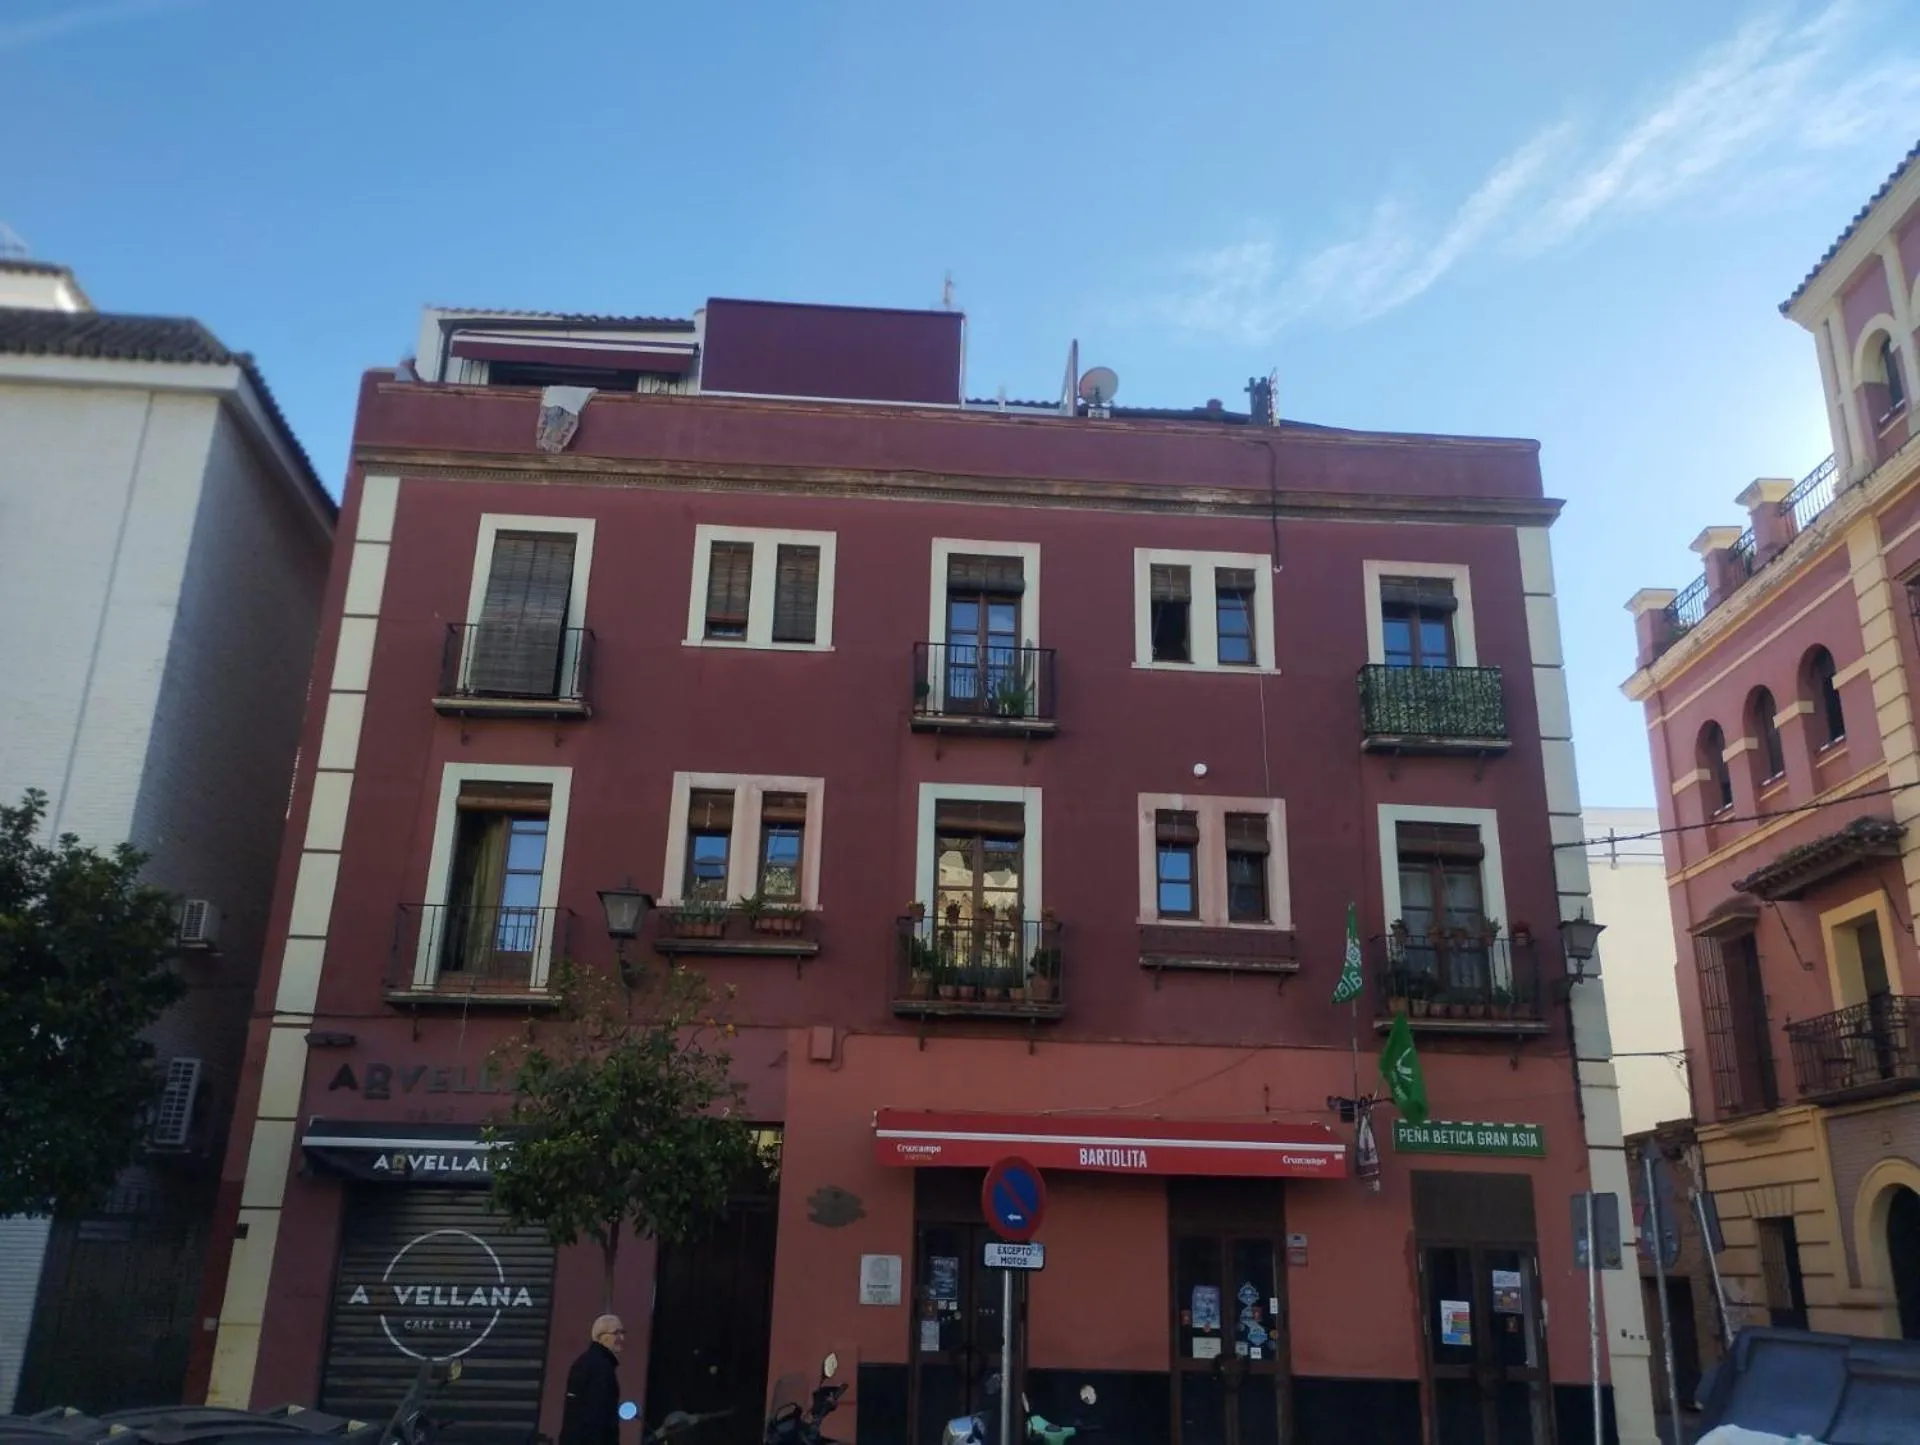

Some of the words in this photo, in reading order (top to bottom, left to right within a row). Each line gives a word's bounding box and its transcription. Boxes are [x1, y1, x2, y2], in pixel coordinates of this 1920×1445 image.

[1398, 1126, 1430, 1144] PEÑA
[1477, 1131, 1509, 1147] GRAN
[1512, 1132, 1538, 1148] ASIA
[896, 1143, 942, 1154] Cruzcampo
[1079, 1148, 1148, 1168] BARTOLITA
[997, 1246, 1032, 1256] EXCEPTO
[1000, 1257, 1029, 1266] MOTOS
